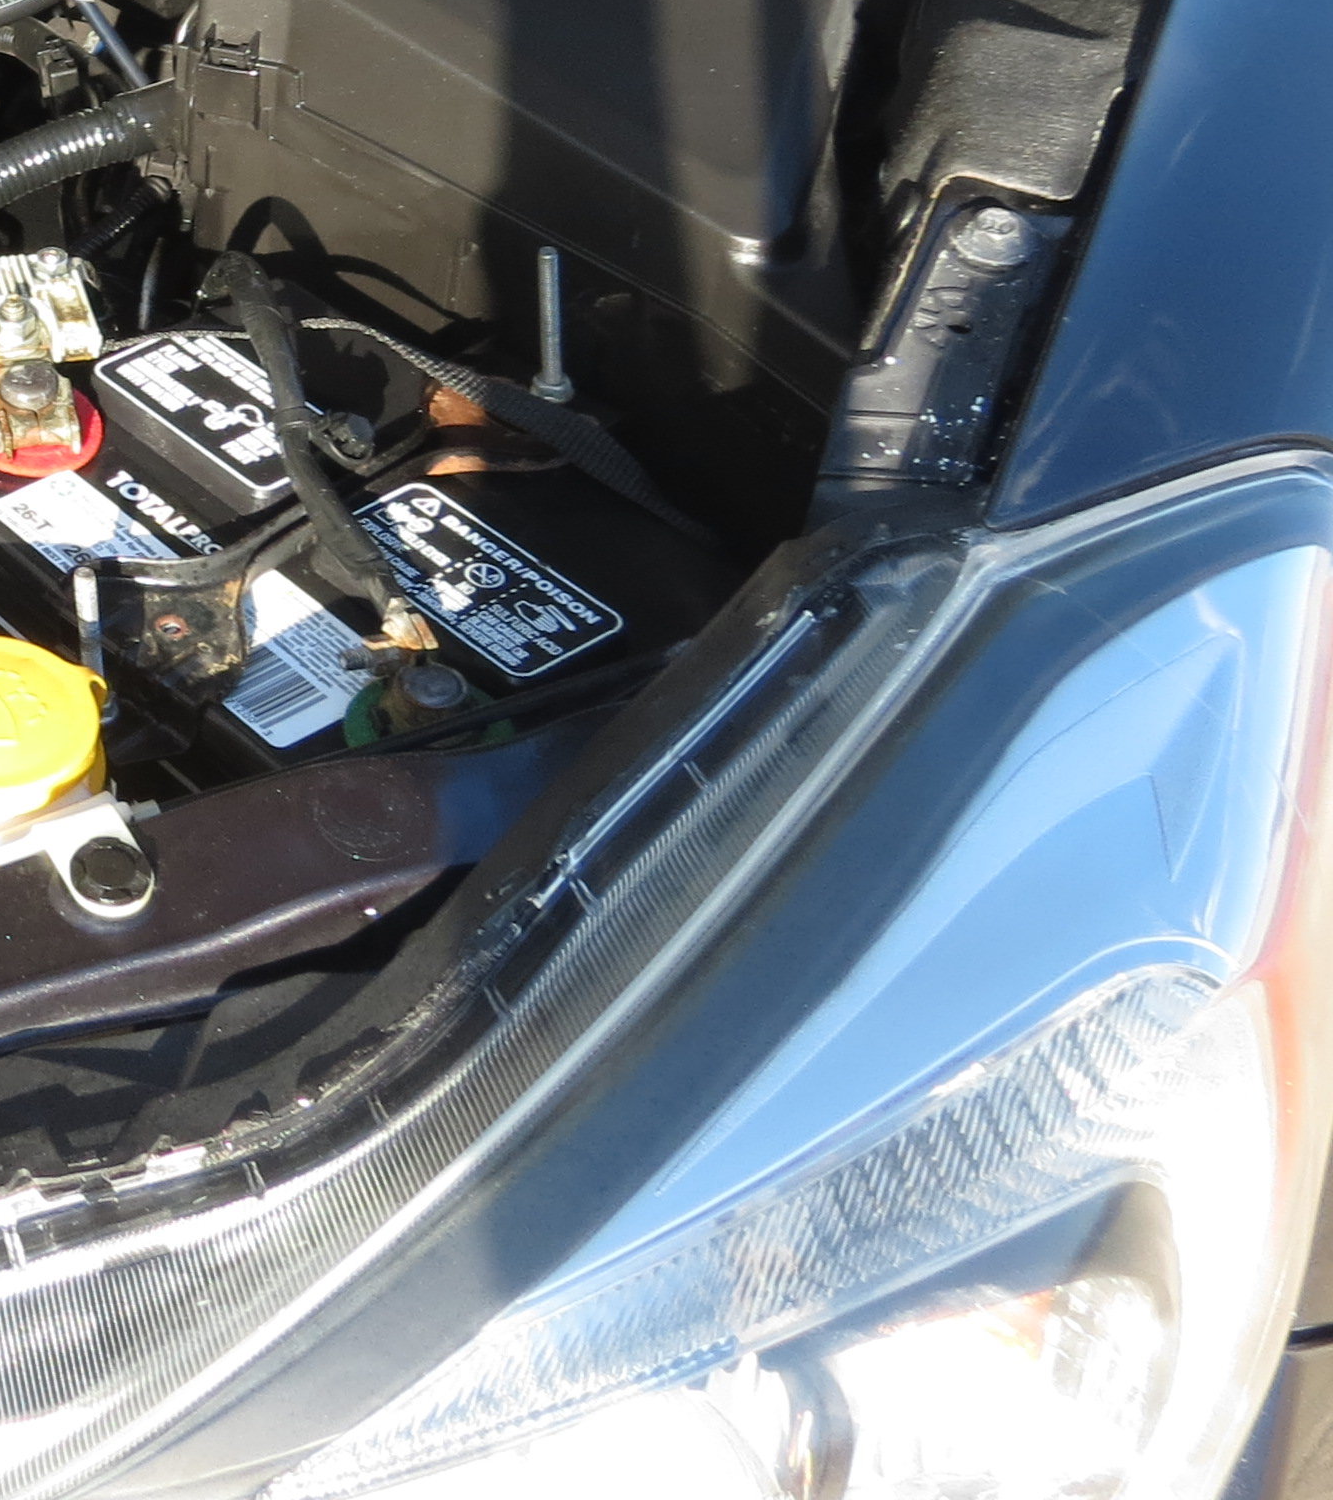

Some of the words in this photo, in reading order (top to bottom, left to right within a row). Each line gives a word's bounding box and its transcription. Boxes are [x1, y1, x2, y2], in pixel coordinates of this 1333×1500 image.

[11, 502, 54, 531] 26-T
[439, 514, 601, 623] DANGER/POISON
[487, 605, 537, 638] SULFURIC
[533, 636, 561, 654] ACID
